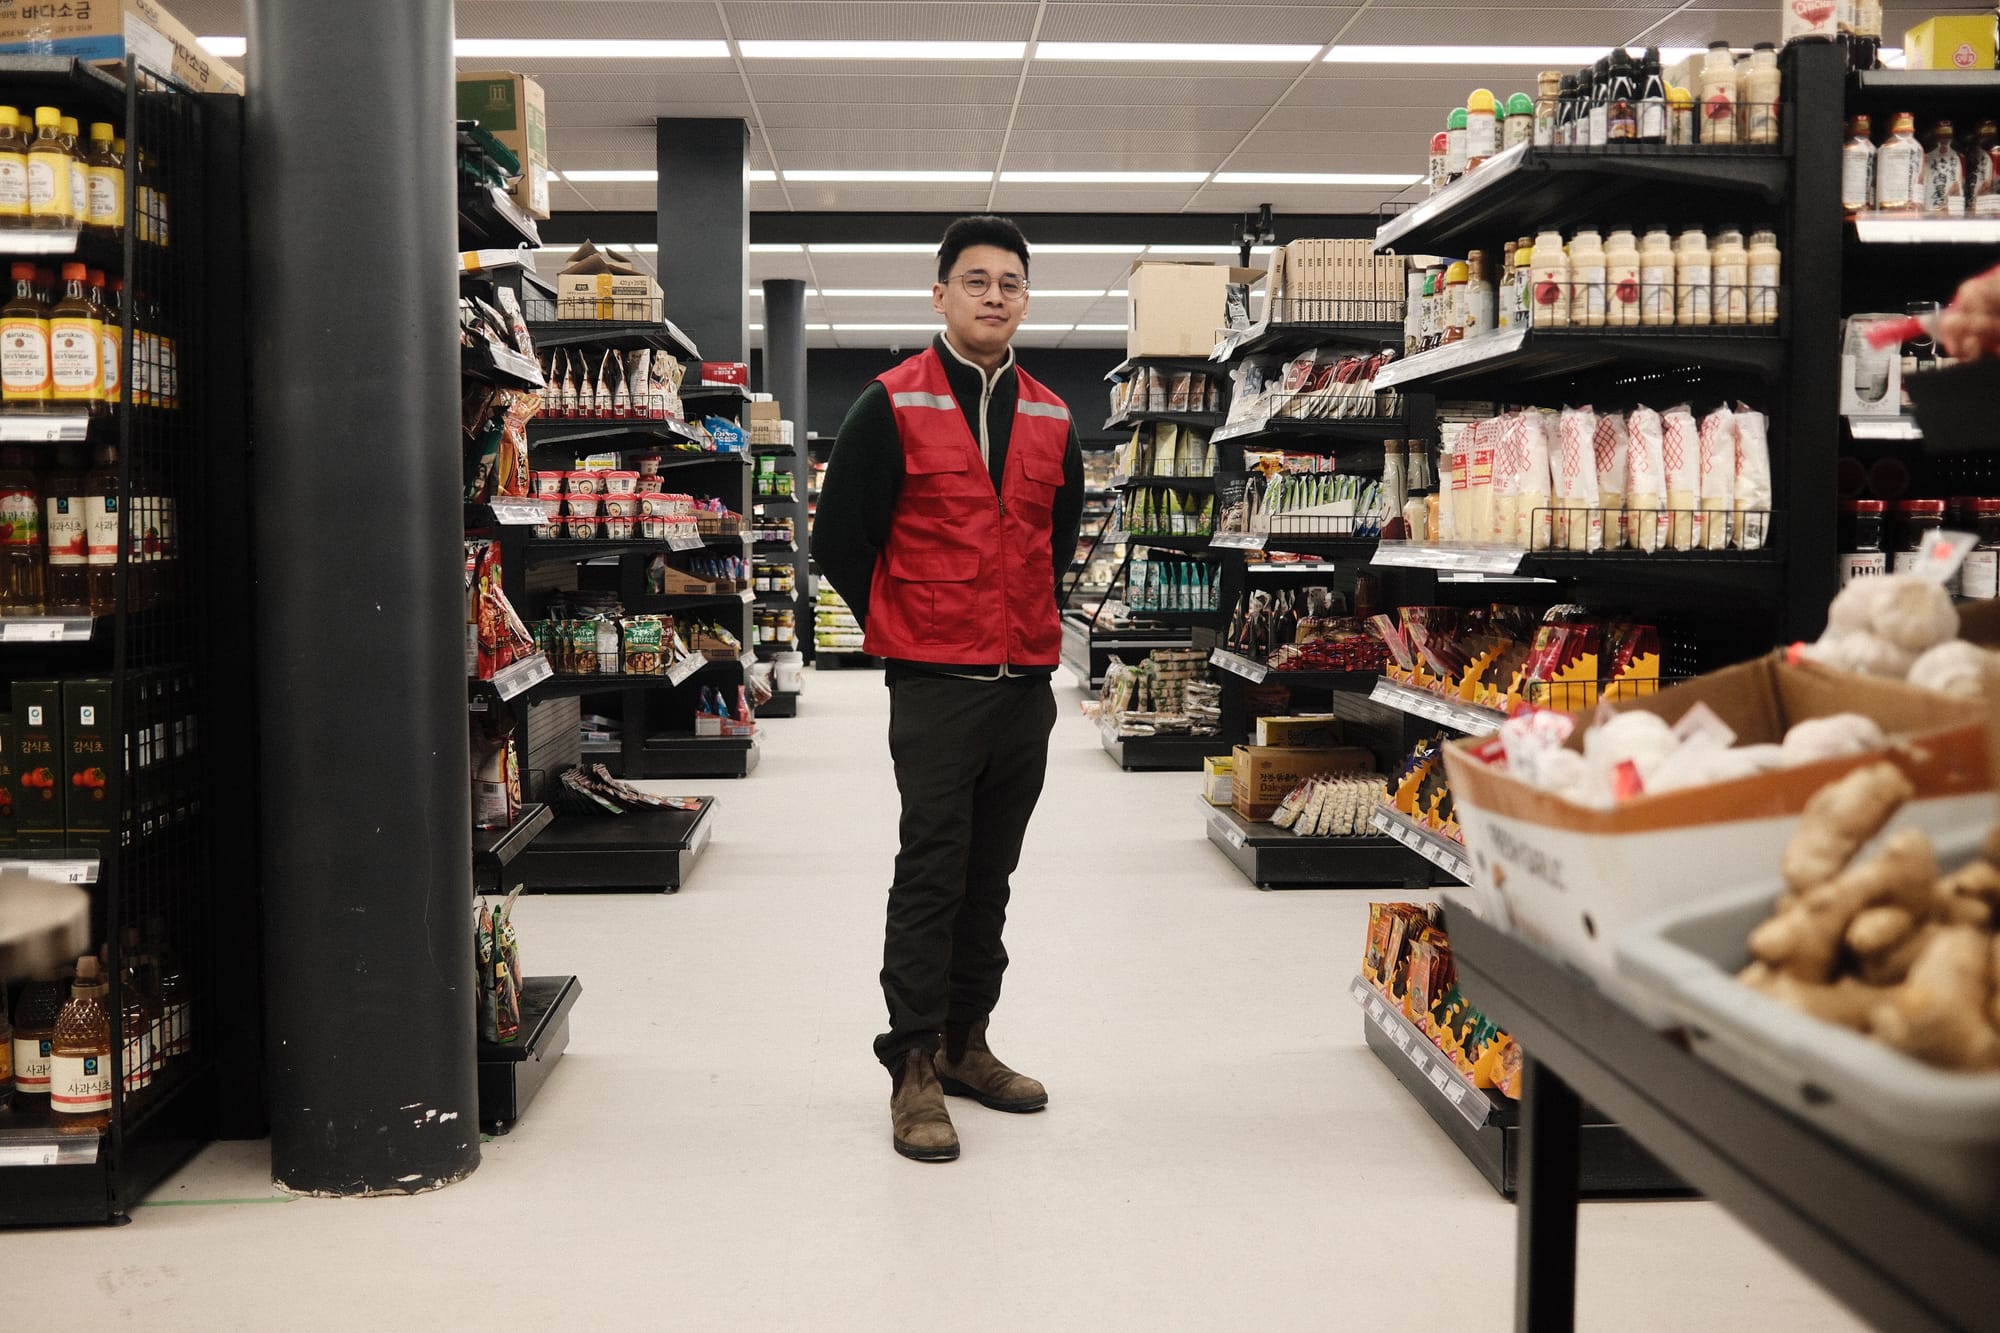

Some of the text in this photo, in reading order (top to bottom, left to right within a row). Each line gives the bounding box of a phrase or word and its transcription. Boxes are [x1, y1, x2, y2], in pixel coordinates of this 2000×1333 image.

[22, 1, 91, 20] 바다소금
[21, 741, 52, 753] 감식초
[73, 741, 104, 753] 감식초
[68, 1080, 111, 1096] 사과식초
